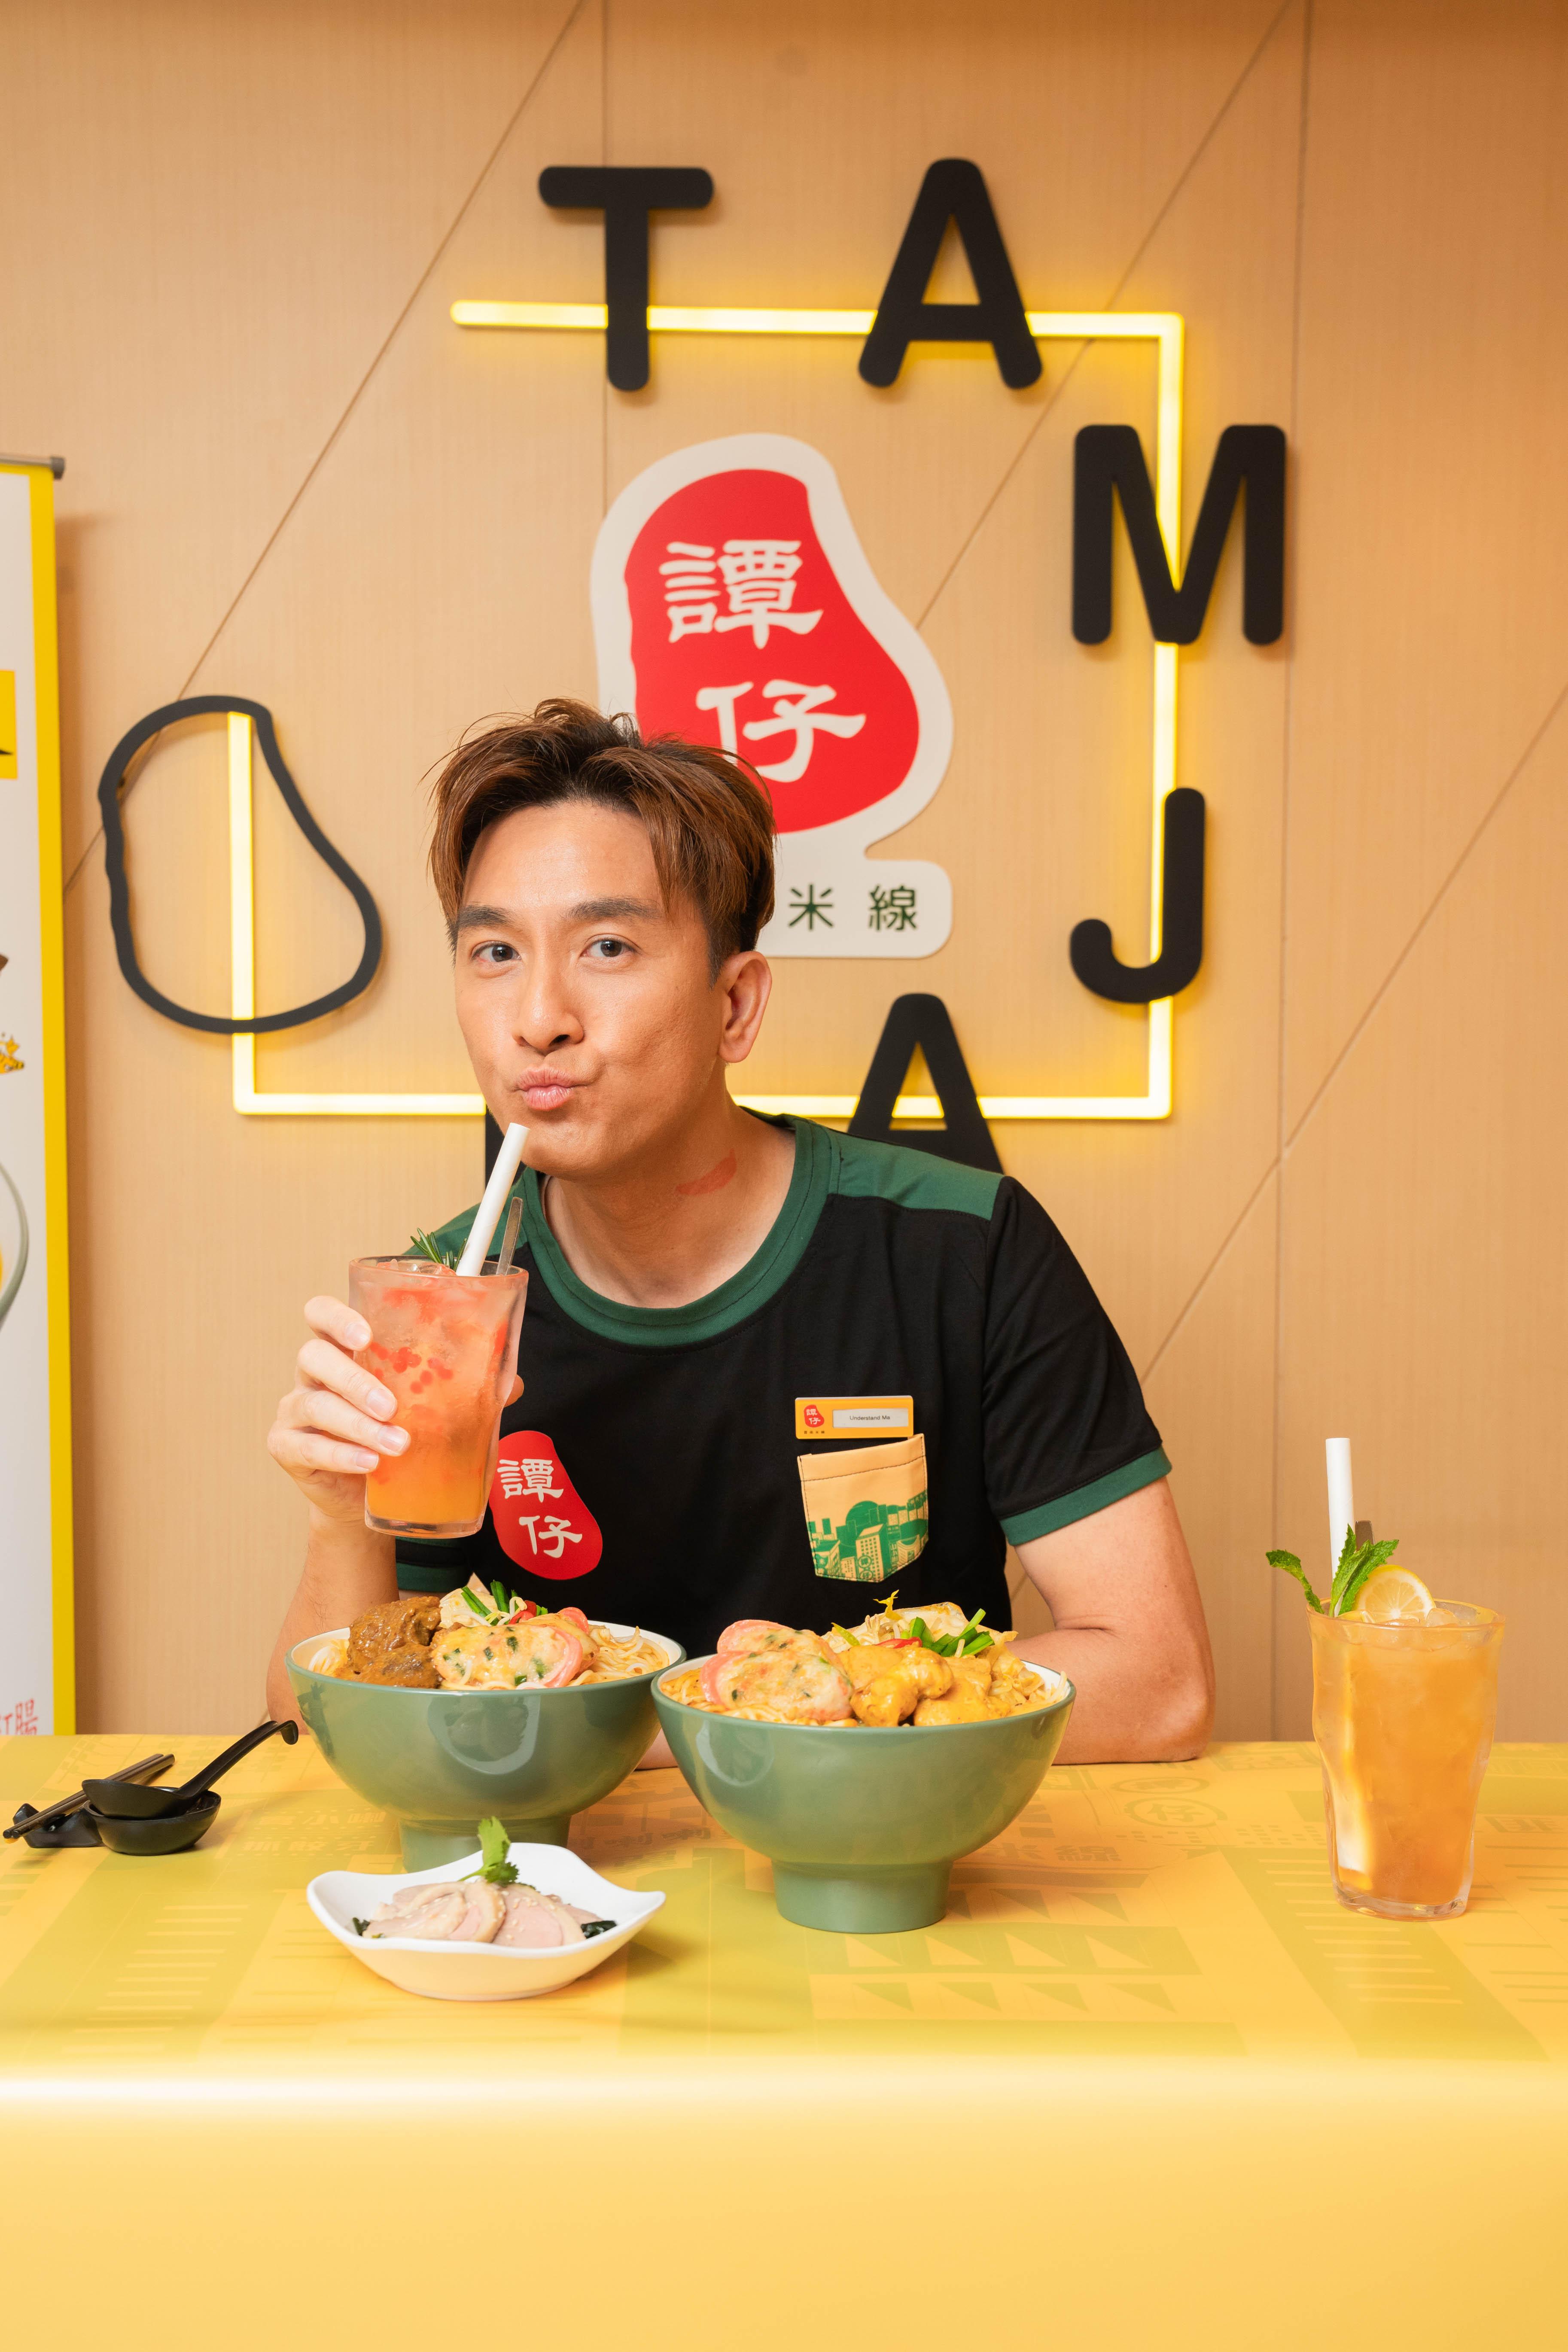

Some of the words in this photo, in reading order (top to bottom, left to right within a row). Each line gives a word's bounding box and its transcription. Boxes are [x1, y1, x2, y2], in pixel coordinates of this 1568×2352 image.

[659, 540, 866, 782] 譚仔
[788, 883, 918, 931] 米線
[497, 1458, 582, 1558] 譚仔
